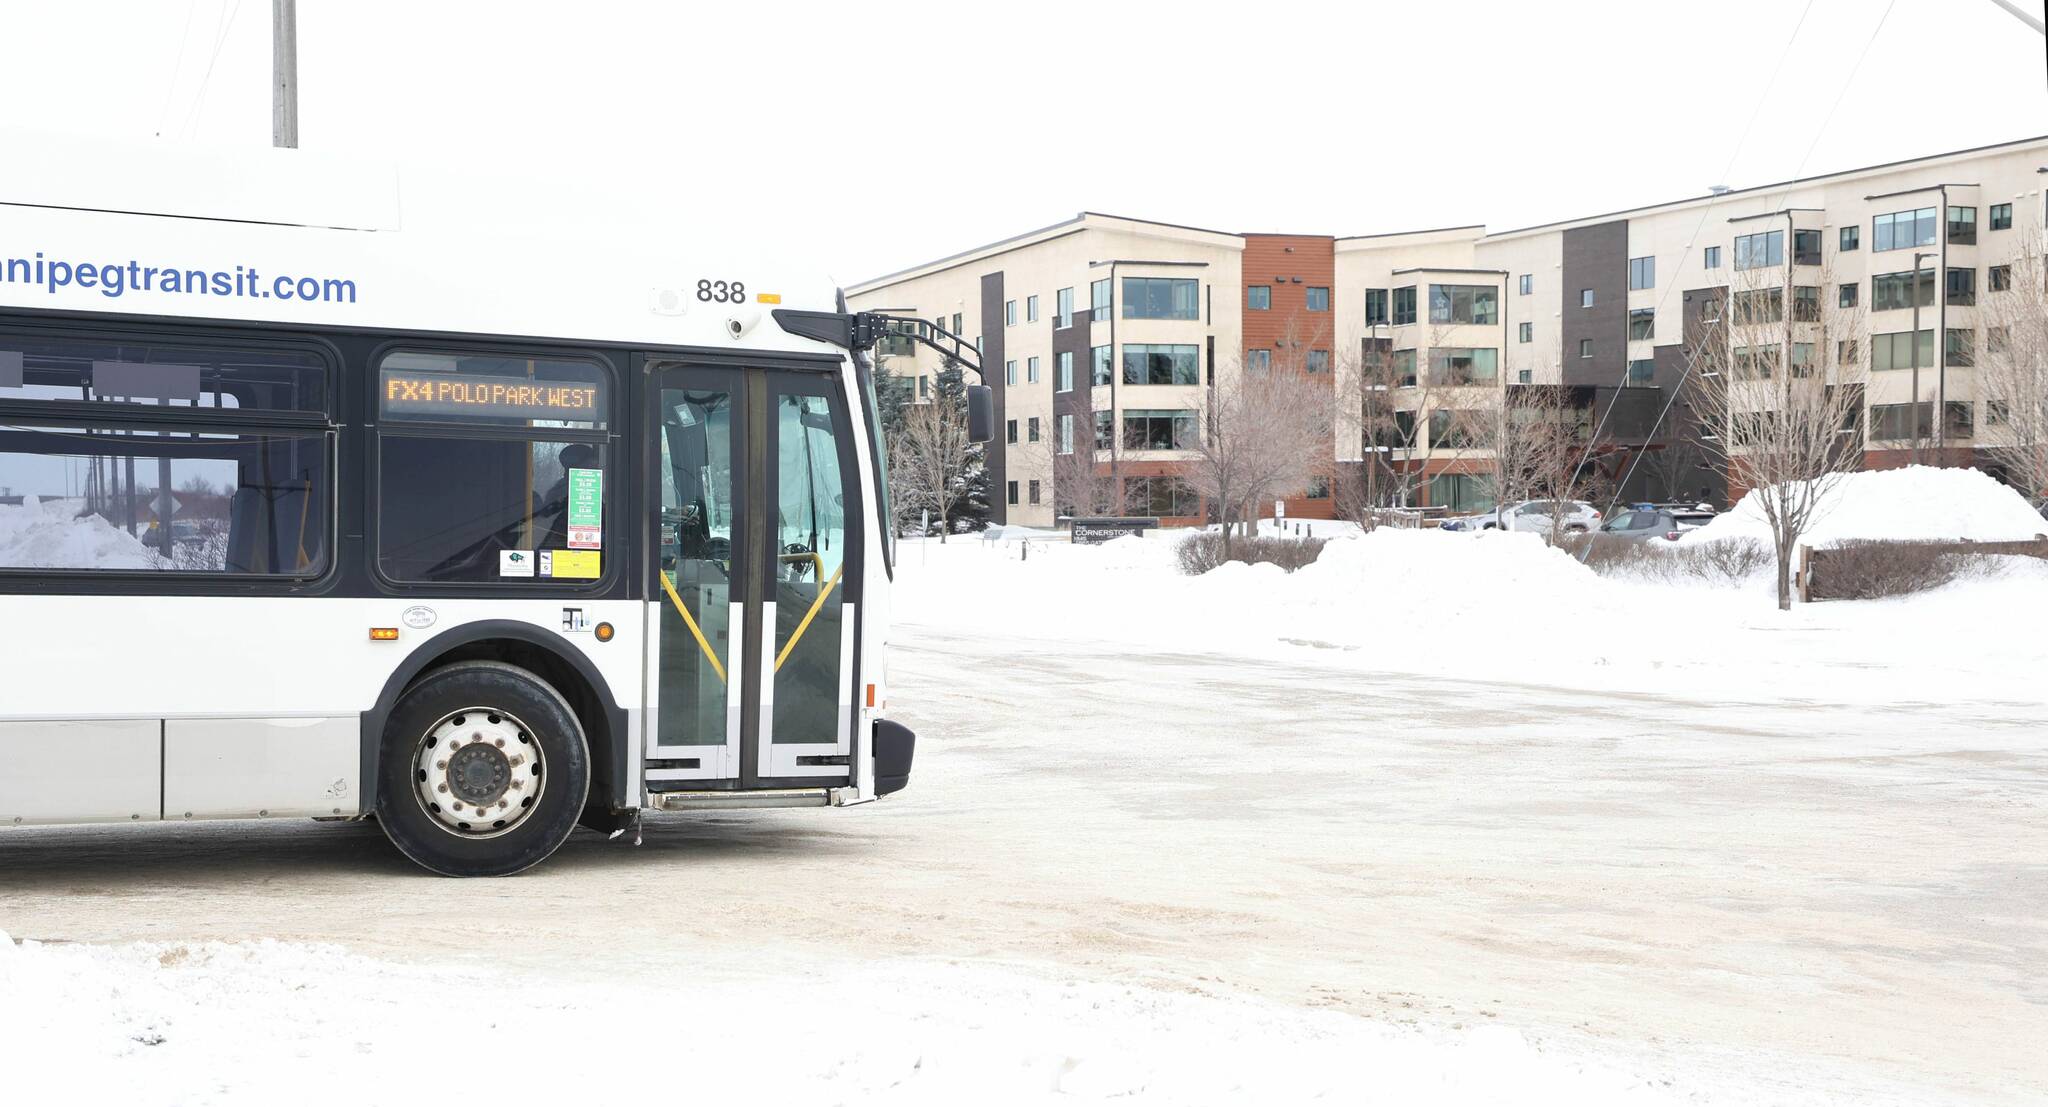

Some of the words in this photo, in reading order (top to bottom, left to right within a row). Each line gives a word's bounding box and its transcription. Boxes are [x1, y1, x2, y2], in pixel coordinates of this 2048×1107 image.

[0, 252, 357, 303] nipegtransit.com
[697, 279, 746, 304] 838
[387, 379, 433, 401] FX4
[439, 382, 488, 403] POLO
[493, 384, 543, 406] PARK
[548, 387, 595, 408] WEST
[1075, 529, 1136, 537] CORNERSTONE
